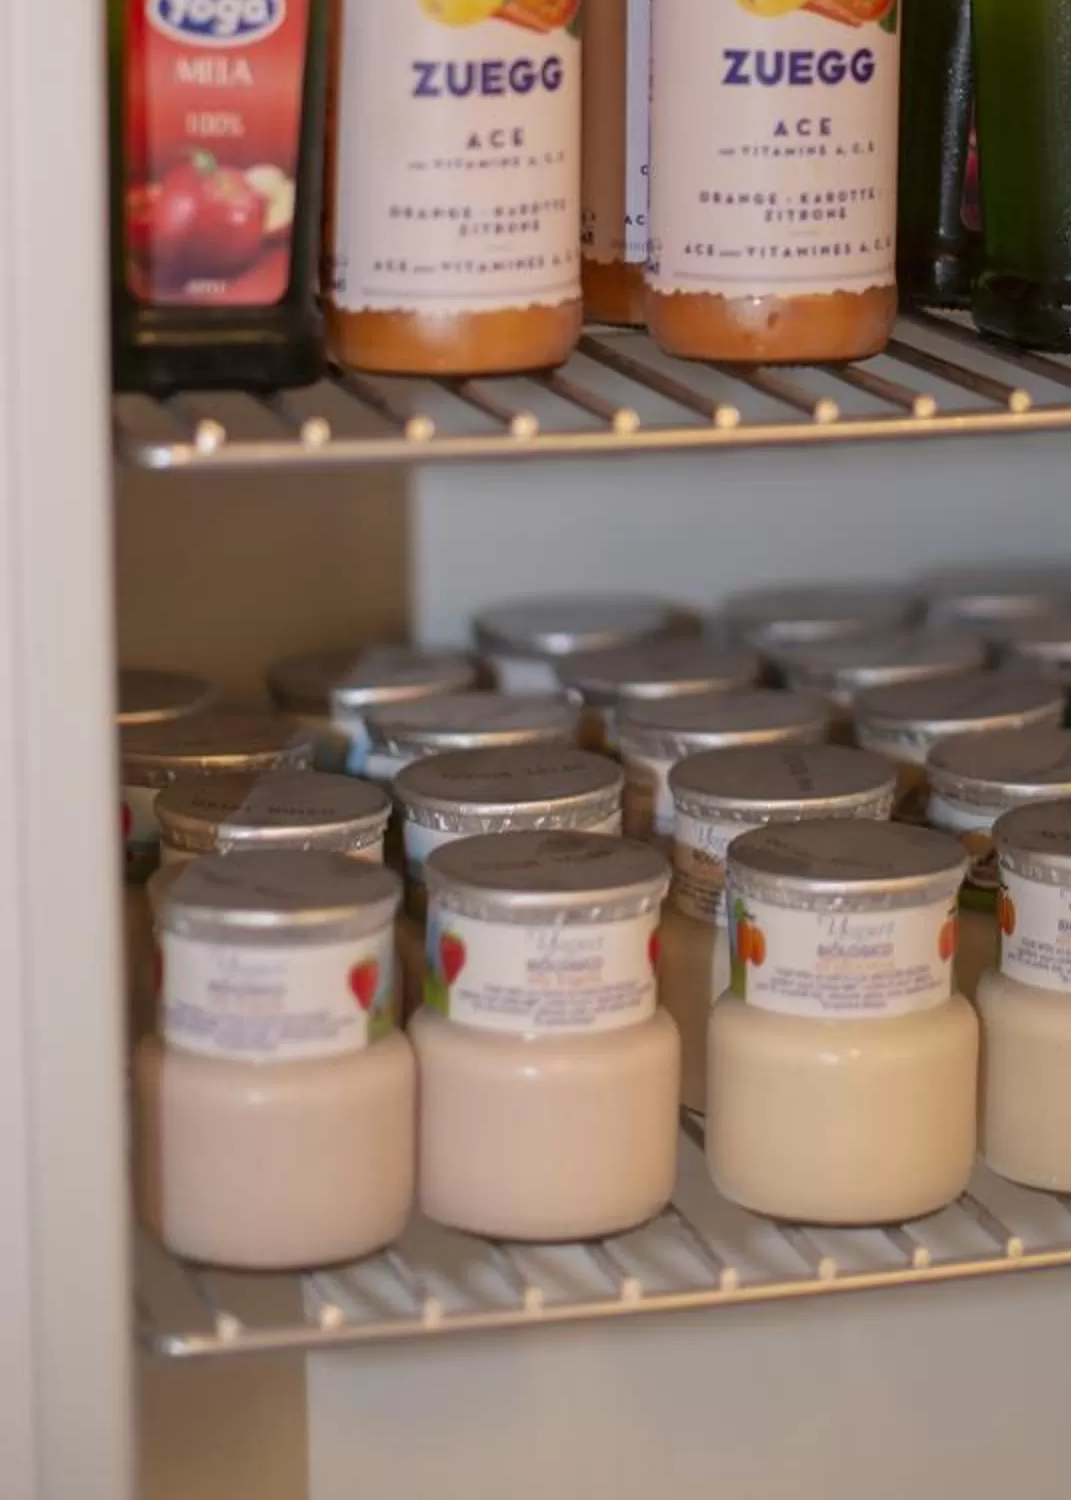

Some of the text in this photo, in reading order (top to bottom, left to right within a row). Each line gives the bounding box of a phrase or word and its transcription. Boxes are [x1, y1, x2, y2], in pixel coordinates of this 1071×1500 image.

[722, 47, 876, 86] ZUEGG
[412, 56, 563, 98] ZUEGG
[774, 117, 832, 137] ACE
[466, 127, 525, 150] ACE
[699, 187, 875, 205] ORANGE KAROTTE
[624, 213, 645, 227] AC
[763, 206, 847, 222] ZITRONE
[684, 243, 715, 257] ACE
[746, 242, 851, 259] VITAMINES
